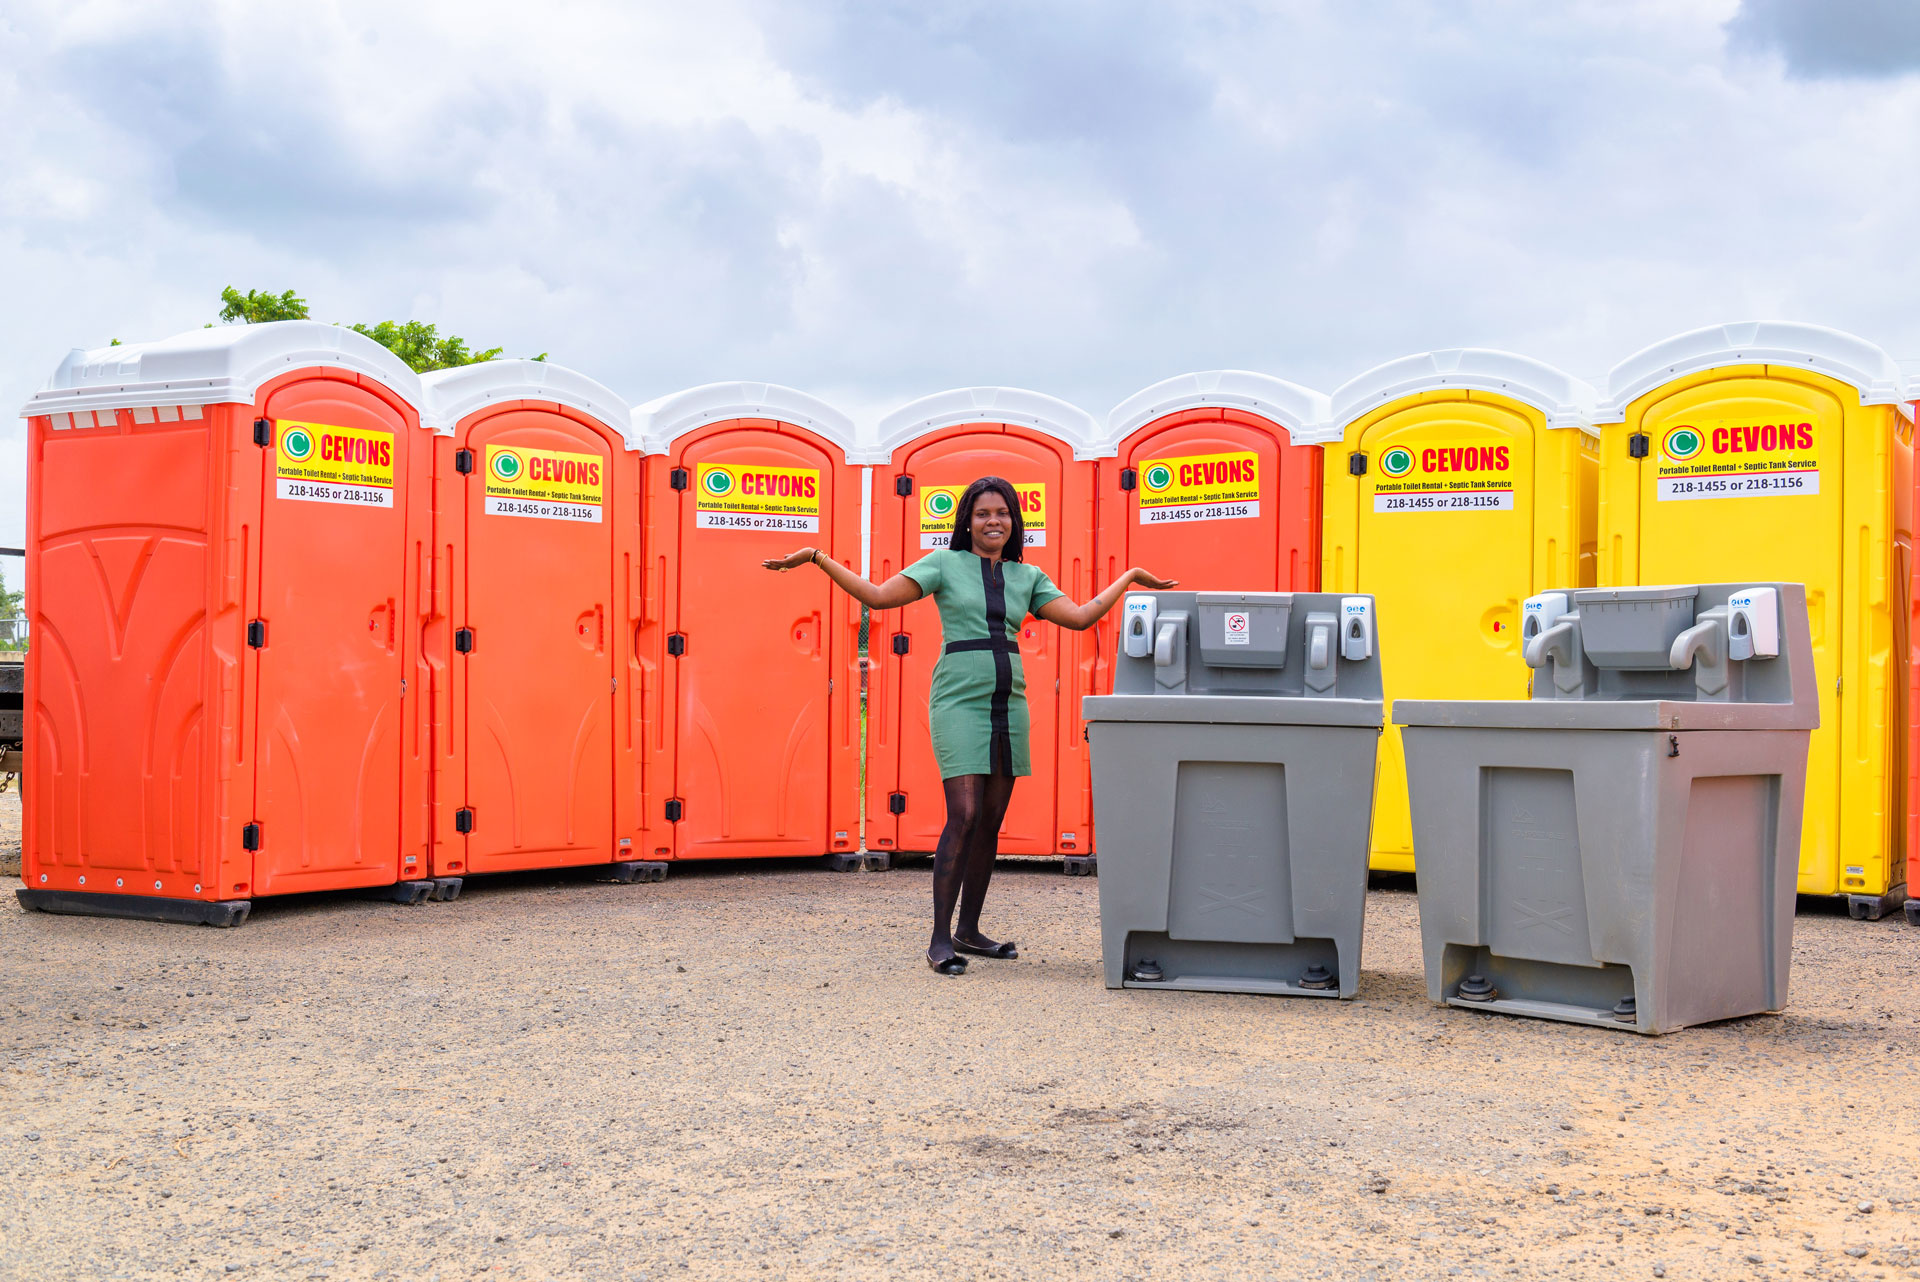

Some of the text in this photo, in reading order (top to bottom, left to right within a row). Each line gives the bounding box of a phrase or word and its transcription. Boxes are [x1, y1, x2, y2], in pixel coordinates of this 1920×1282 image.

[1712, 423, 1813, 454] CEVONS
[321, 434, 390, 467] CEVONS
[1422, 446, 1509, 472] CEVONS
[1659, 466, 1689, 474] Portable
[1691, 465, 1711, 473] Toilet
[1713, 464, 1736, 472] Rental
[1744, 462, 1767, 470] Septic
[1788, 460, 1816, 468] Service
[278, 467, 302, 476] Portable
[304, 469, 319, 477] Toilet
[320, 471, 337, 479] Rental
[342, 473, 359, 481] Septic
[374, 476, 392, 484] Service
[529, 457, 599, 486] CEVONS
[1180, 459, 1254, 487] CEVONS
[741, 473, 815, 498] CEVONS
[1487, 480, 1511, 488] Service
[1672, 477, 1803, 493] 218-1455 or 218-1156
[289, 485, 383, 502] 218-1455 or 218-1156
[487, 486, 511, 494] Portable
[529, 489, 546, 497] Rental
[552, 491, 568, 499] Septic
[583, 494, 601, 502] Service
[1141, 497, 1163, 505] Portable
[1204, 493, 1221, 501] Septic
[497, 502, 592, 518] 218-1455 or 218-1156
[1387, 497, 1499, 508] 218-1455 or 218-1156
[1151, 506, 1247, 520] 218-1455 or 218-1156
[708, 516, 751, 526] 218-1455
[766, 519, 807, 528] 218-1156
